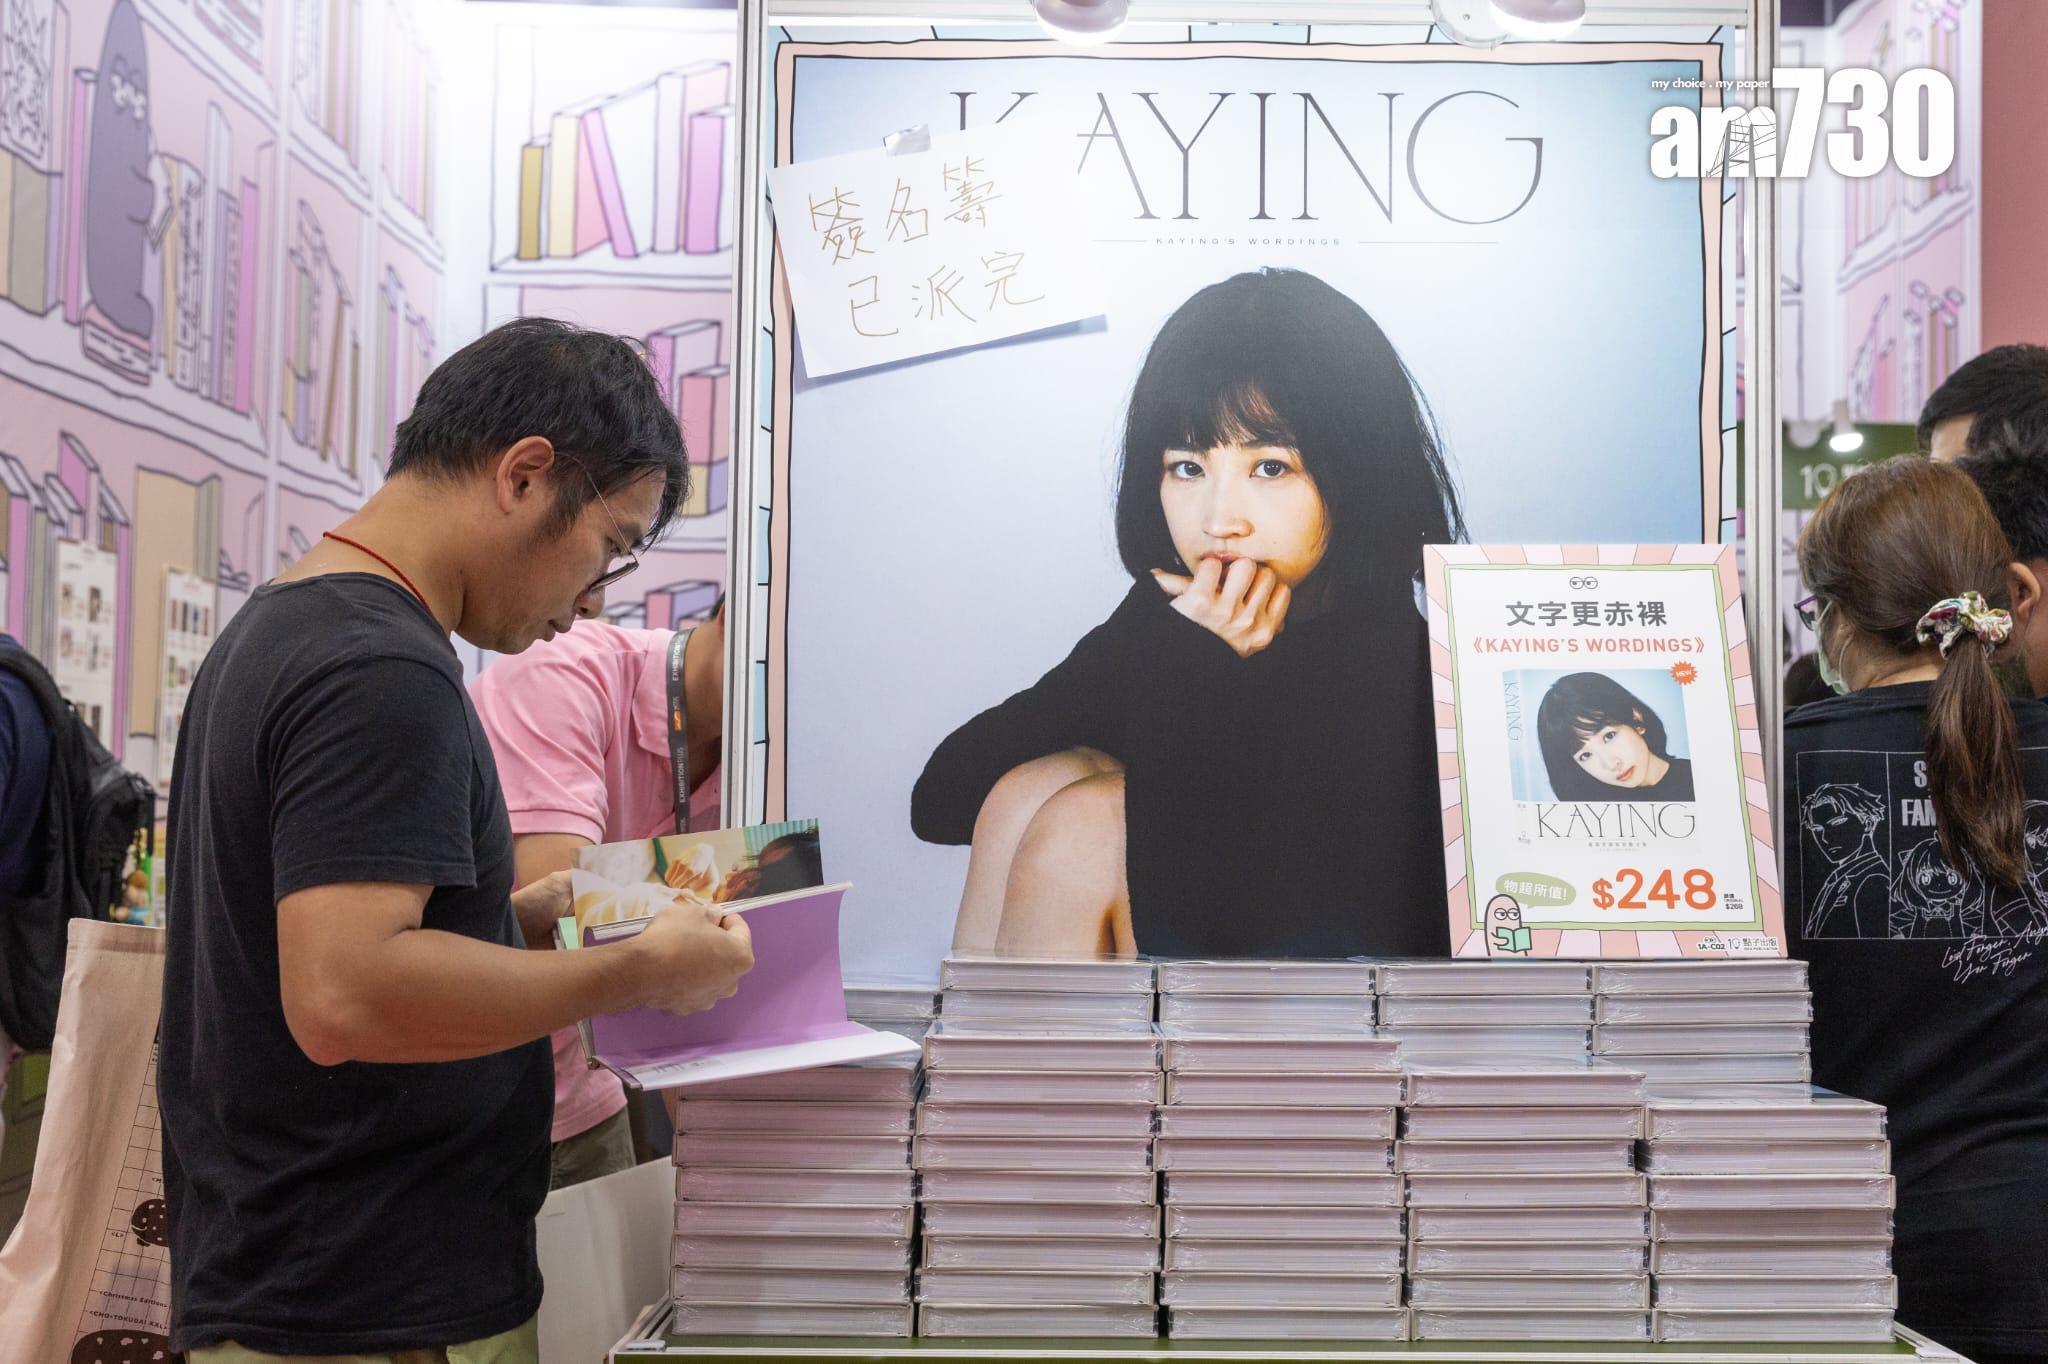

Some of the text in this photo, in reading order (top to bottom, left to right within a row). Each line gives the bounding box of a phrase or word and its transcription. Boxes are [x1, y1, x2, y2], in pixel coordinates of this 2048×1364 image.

[1156, 237, 1342, 247] KAYING'S WORDINGS
[1504, 600, 1668, 627] 文字更赤裸
[1505, 681, 1523, 741] KAYING
[1537, 803, 1696, 839] KAYING
[1503, 879, 1568, 901] 物超所值!
[1592, 868, 1717, 911] $248
